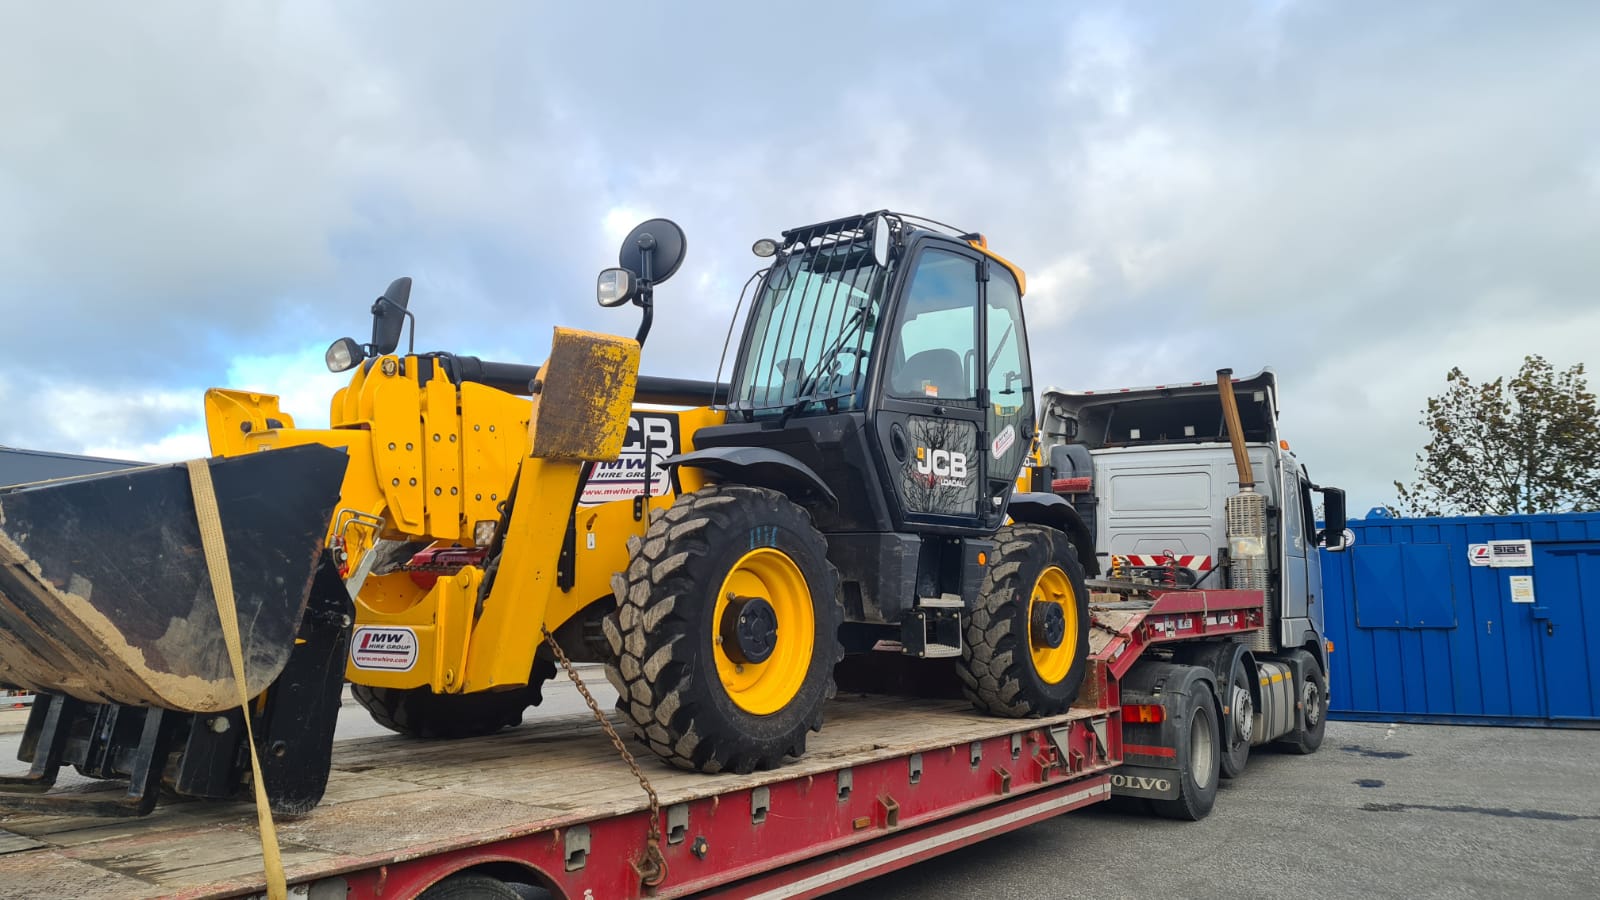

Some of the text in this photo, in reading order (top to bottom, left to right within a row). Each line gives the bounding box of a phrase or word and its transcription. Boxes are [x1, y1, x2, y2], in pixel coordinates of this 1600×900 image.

[620, 417, 674, 458] CB
[917, 447, 967, 478] JCB
[596, 471, 623, 479] HIRE
[582, 487, 659, 496] ww.mwhire.cm
[371, 633, 404, 643] MW
[356, 656, 408, 664] www.mwhire.com
[1111, 774, 1171, 793] OLVO
